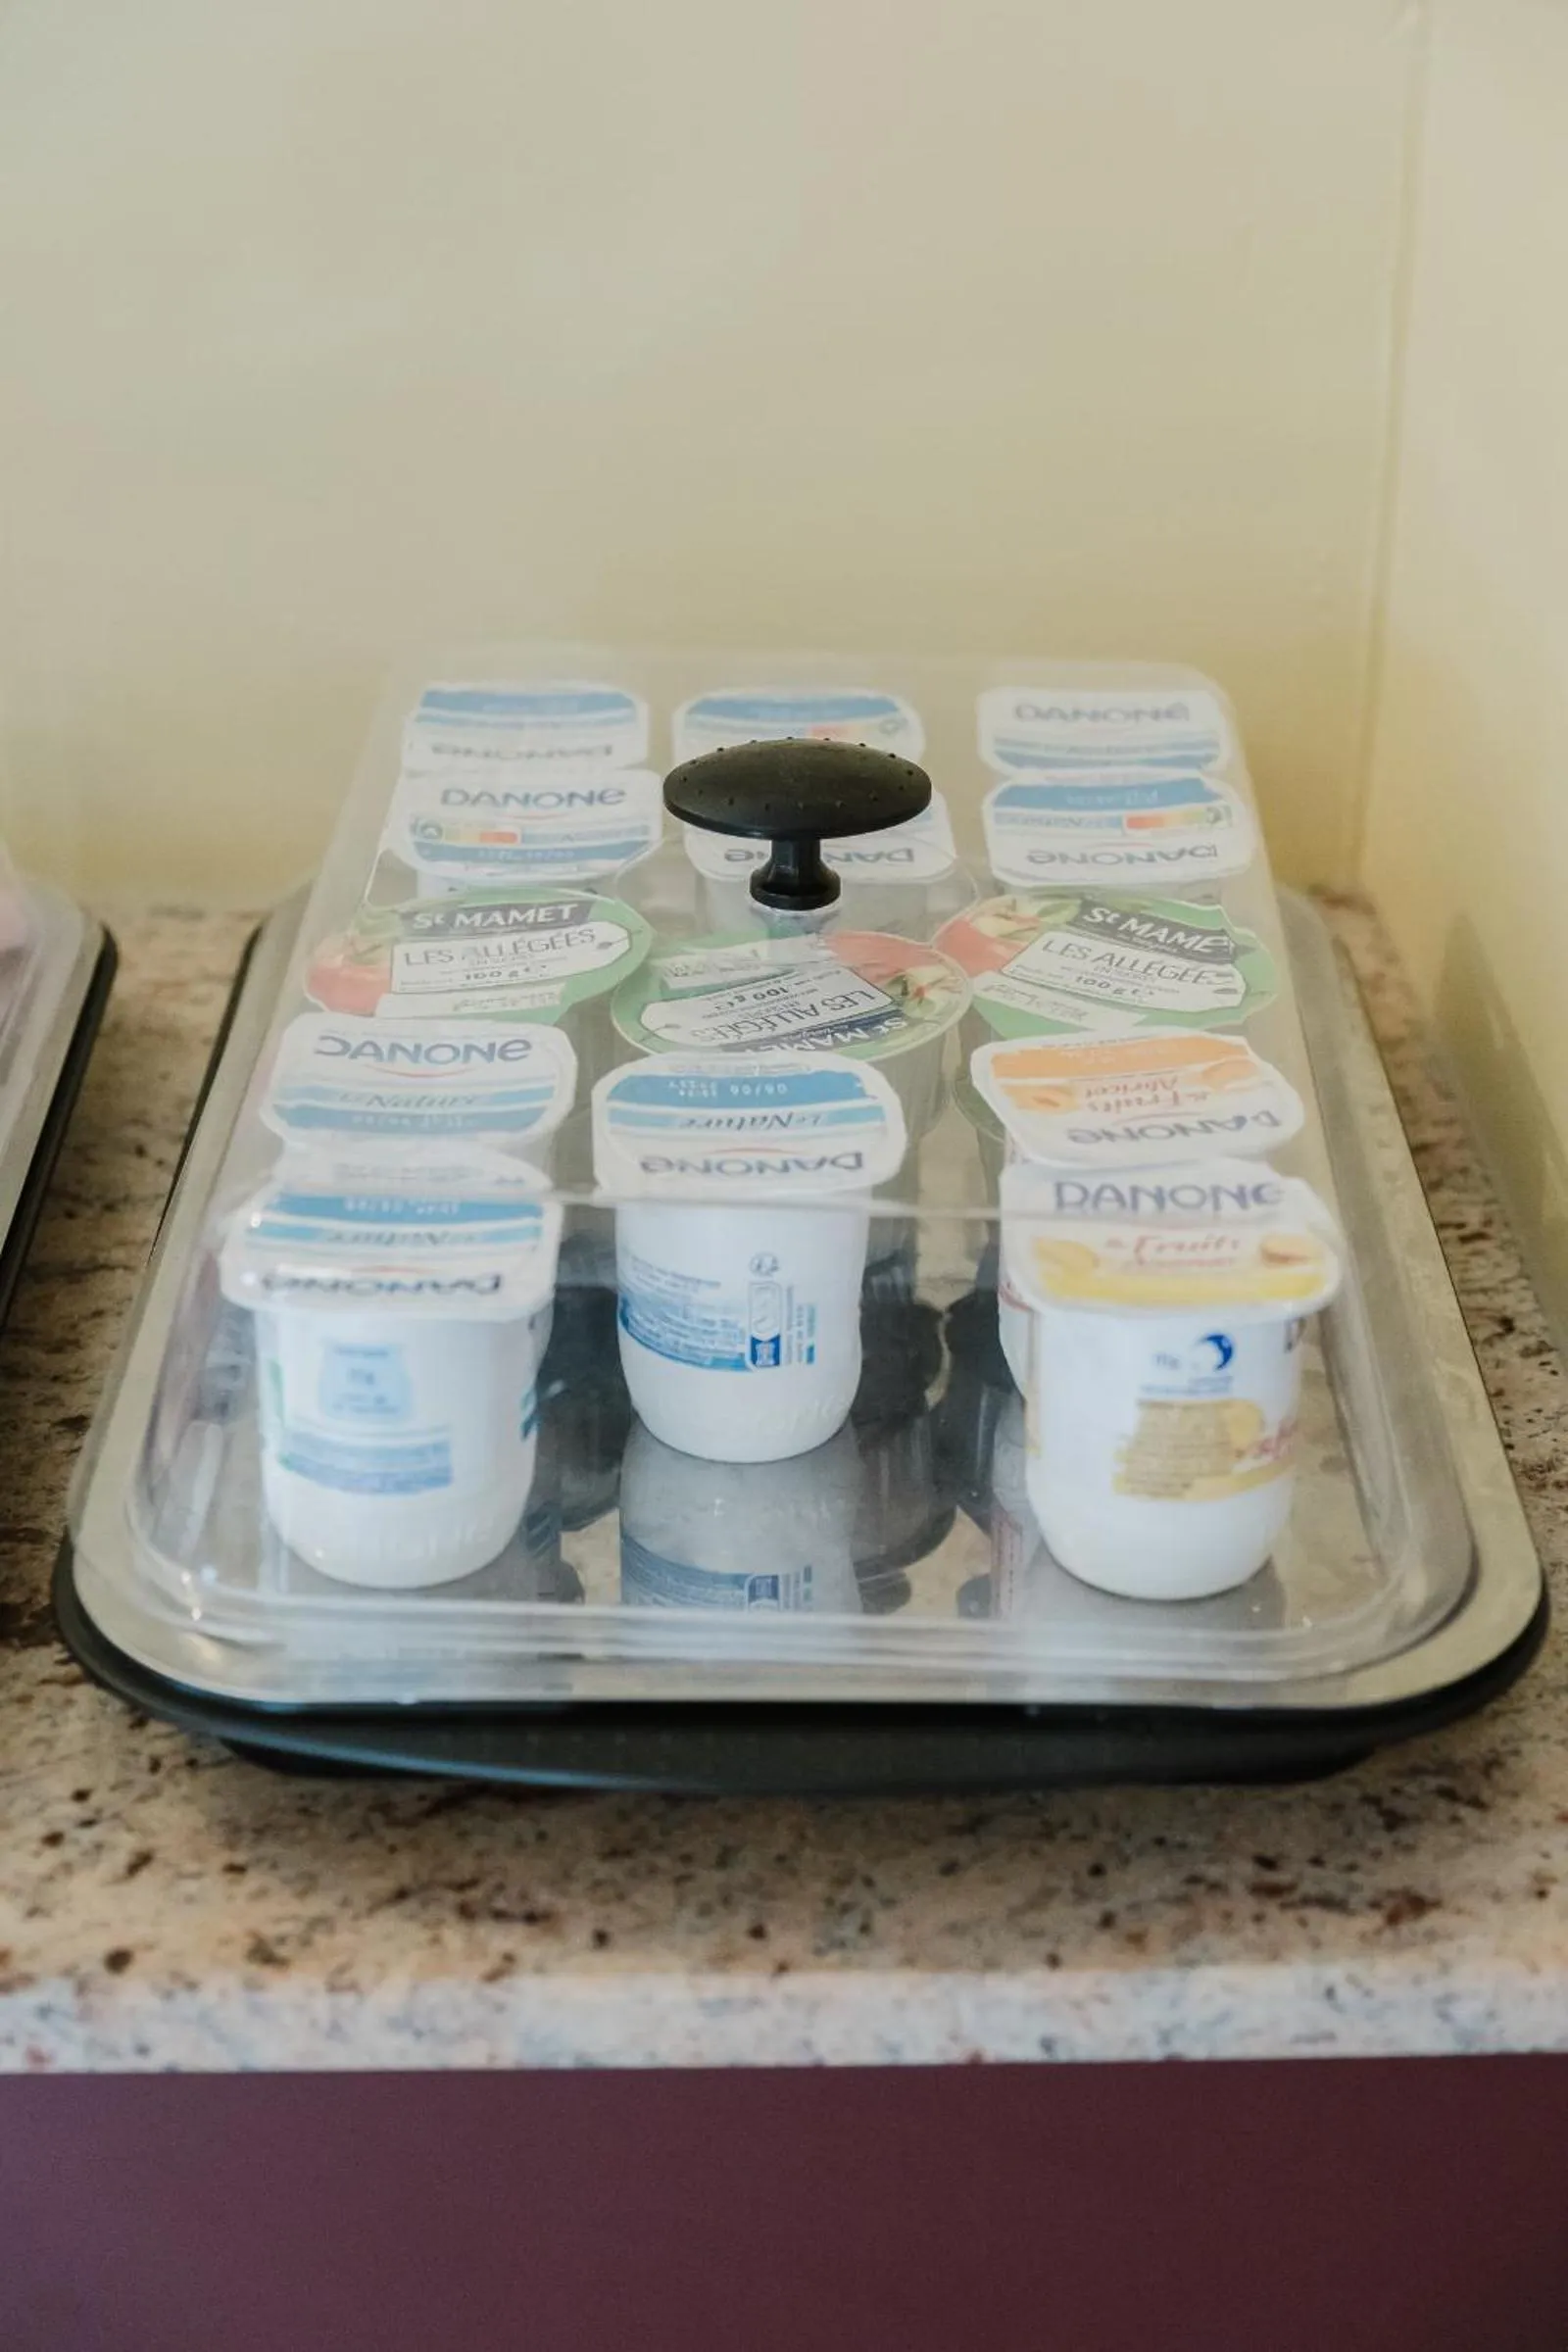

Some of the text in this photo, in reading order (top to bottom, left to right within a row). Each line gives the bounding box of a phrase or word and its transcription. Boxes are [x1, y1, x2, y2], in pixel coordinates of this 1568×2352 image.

[440, 787, 628, 809] DANONE
[1025, 844, 1219, 865] DANONE
[453, 903, 580, 929] MAMET
[1041, 938, 1093, 962] LES
[752, 986, 789, 1001] 100
[820, 989, 877, 1012] LES
[313, 1035, 533, 1065] DANONE
[683, 1111, 796, 1131] Nature
[1066, 1109, 1283, 1145] DANONE
[639, 1152, 864, 1176] DANONE
[1053, 1179, 1286, 1212] DANONE
